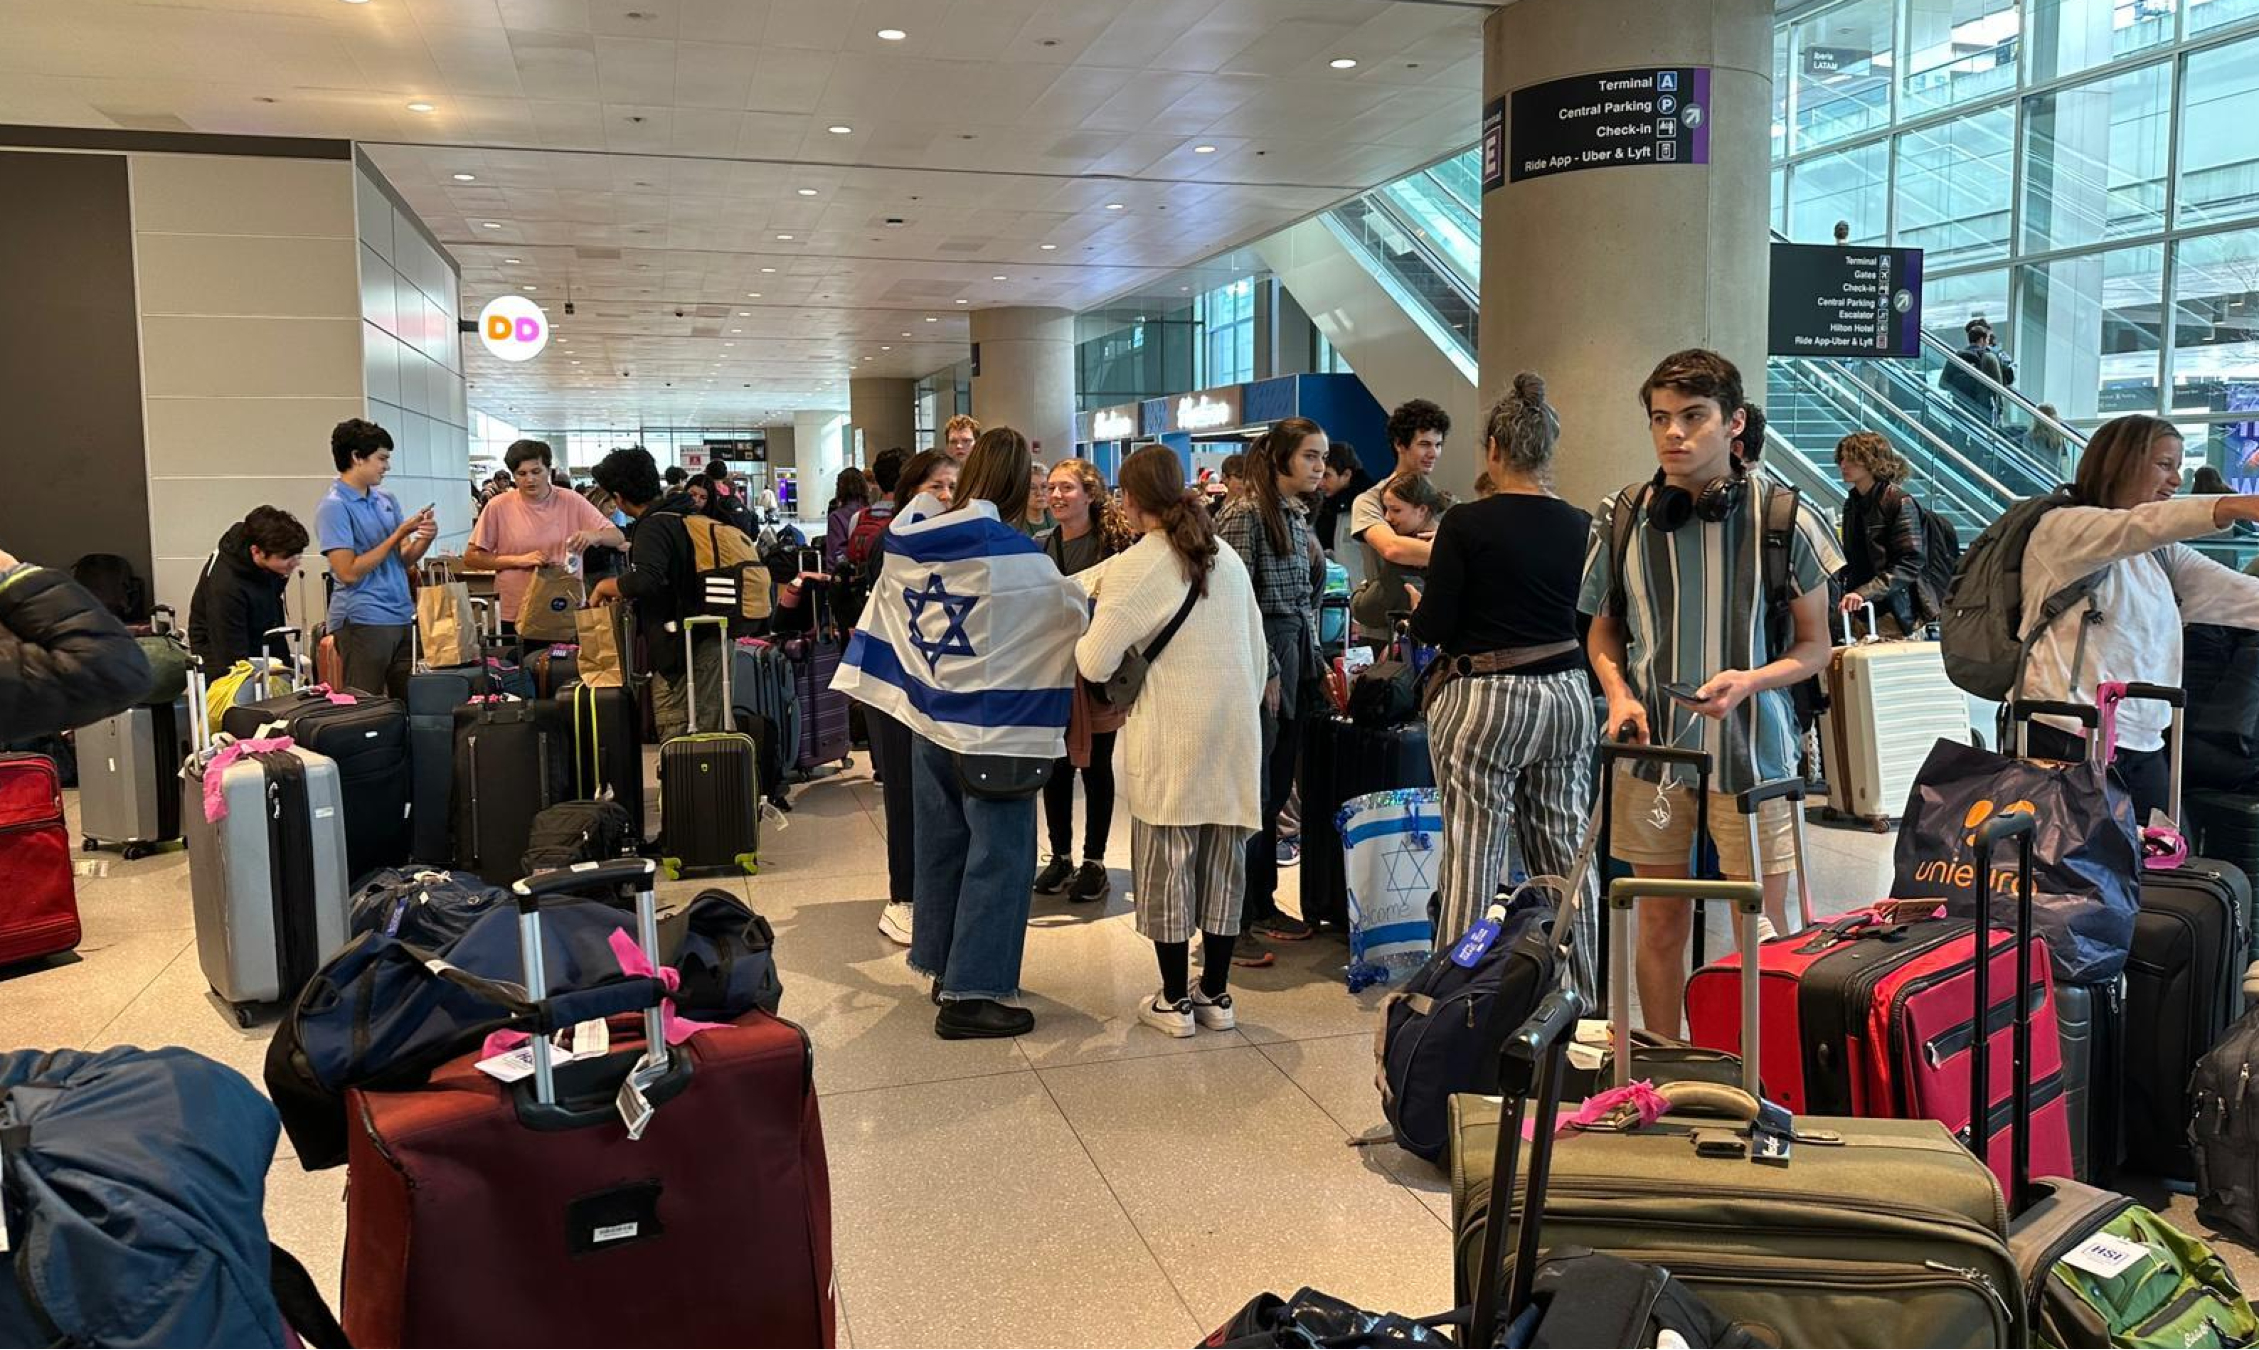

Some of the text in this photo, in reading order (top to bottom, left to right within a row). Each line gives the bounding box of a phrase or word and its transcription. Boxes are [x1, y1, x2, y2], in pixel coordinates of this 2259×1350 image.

[1813, 62, 1839, 70] LATAM
[1599, 76, 1652, 92] Terminal
[1558, 103, 1601, 120] Central
[1604, 99, 1652, 114] Parking
[1596, 123, 1651, 137] Check-in
[1484, 135, 1496, 176] E
[1524, 158, 1547, 172] Ride
[1549, 156, 1572, 170] App
[1582, 150, 1611, 162] Uber
[1615, 148, 1624, 159] &
[1628, 145, 1651, 159] Lyft
[1845, 256, 1877, 266] Terminal
[1854, 270, 1876, 279] Gates
[1842, 283, 1876, 292] Check-in
[1817, 297, 1846, 307] Central
[1846, 298, 1875, 309] Parking
[1838, 310, 1874, 319] Escalator
[487, 315, 540, 343] DD
[1830, 323, 1874, 333] Hilton Hotel
[1794, 336, 1812, 345] Ride
[1851, 337, 1858, 345] &
[1860, 337, 1873, 348] Lyft
